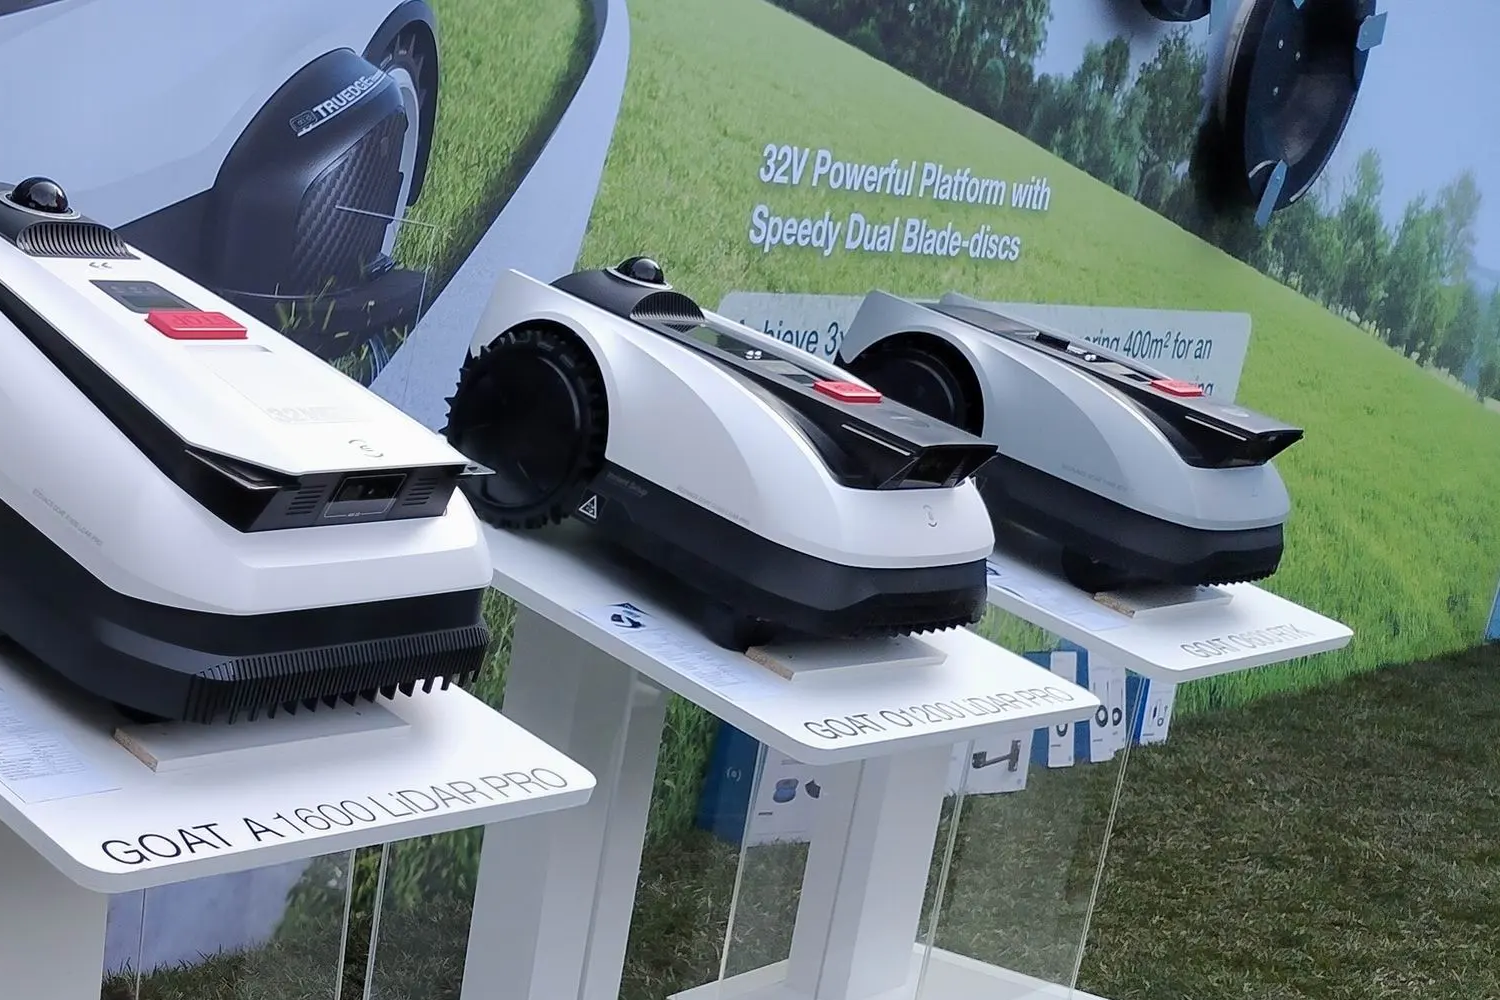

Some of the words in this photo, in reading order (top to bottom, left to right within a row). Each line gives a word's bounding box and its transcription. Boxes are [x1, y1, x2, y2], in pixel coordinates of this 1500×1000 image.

[312, 76, 372, 118] TRUEDGE
[759, 143, 809, 185] 32V
[812, 149, 916, 197] Powerful
[918, 162, 1006, 206] Platform
[1011, 176, 1051, 211] with
[749, 204, 841, 256] Speedy
[845, 212, 900, 253] Dual
[902, 218, 1021, 262] Blade-discs
[1172, 332, 1193, 359] for
[1194, 337, 1213, 360] an
[1180, 638, 1241, 658] GOAT
[804, 714, 887, 739] GOAT
[879, 702, 966, 728] O1200
[1015, 686, 1075, 706] PRO
[101, 823, 233, 866] GOAT
[243, 799, 377, 843] A1600
[367, 780, 482, 819] LiDAR
[480, 767, 568, 799] PRO
